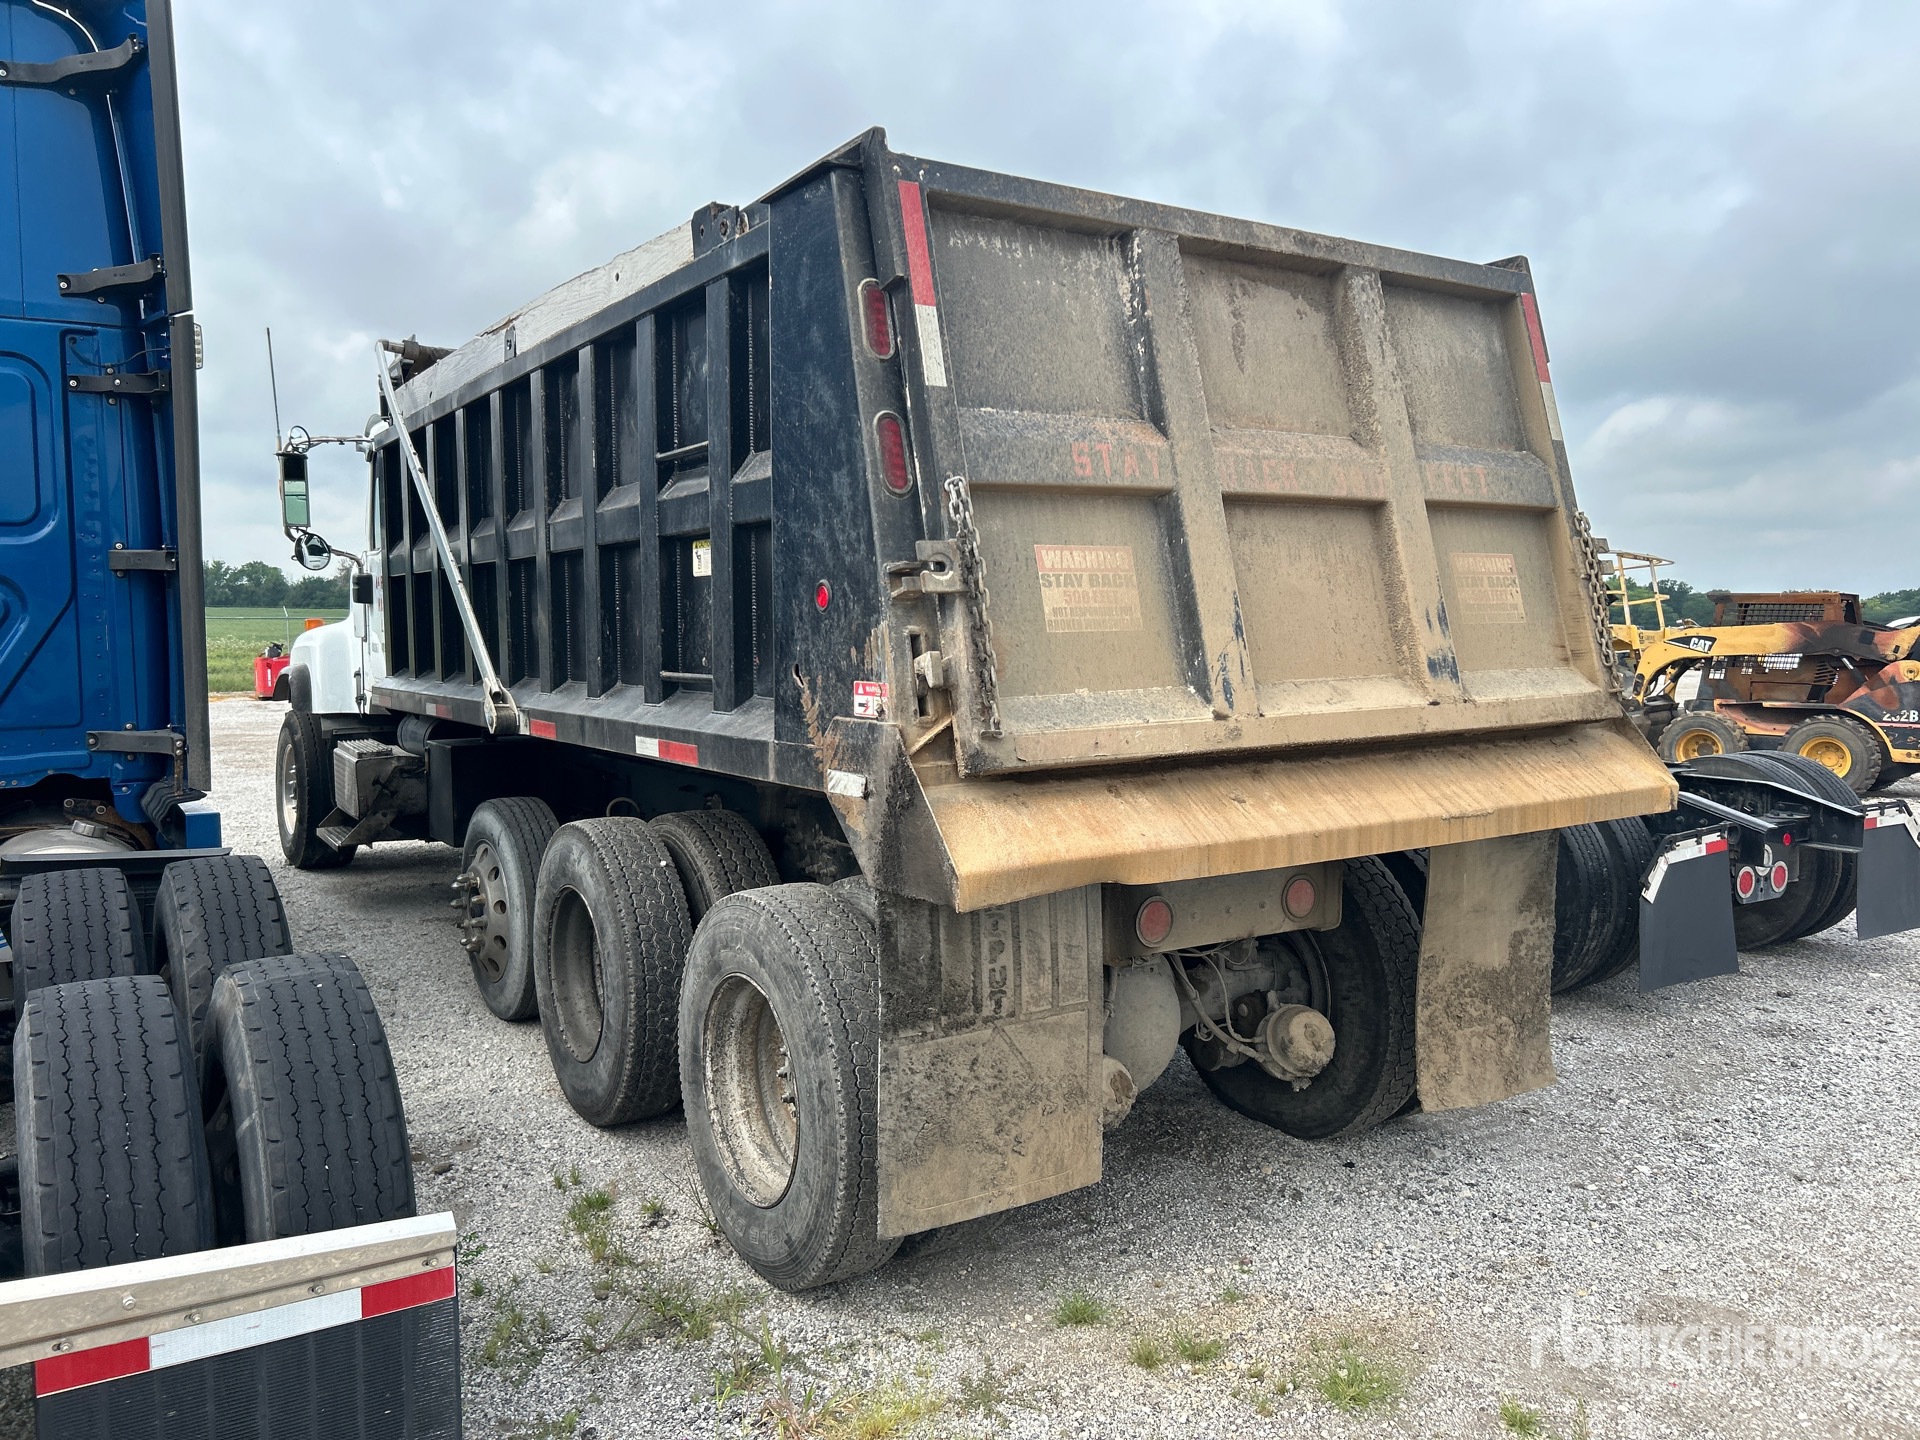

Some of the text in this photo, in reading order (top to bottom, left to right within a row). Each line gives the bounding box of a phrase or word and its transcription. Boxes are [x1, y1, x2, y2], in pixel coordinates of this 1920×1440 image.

[1071, 441, 1161, 479] STAY
[1041, 549, 1129, 569] WARNING
[1454, 557, 1512, 573] WARNING
[1040, 573, 1137, 588] STAY BACK
[1456, 576, 1519, 588] STAY BACK
[1689, 637, 1713, 654] CAT
